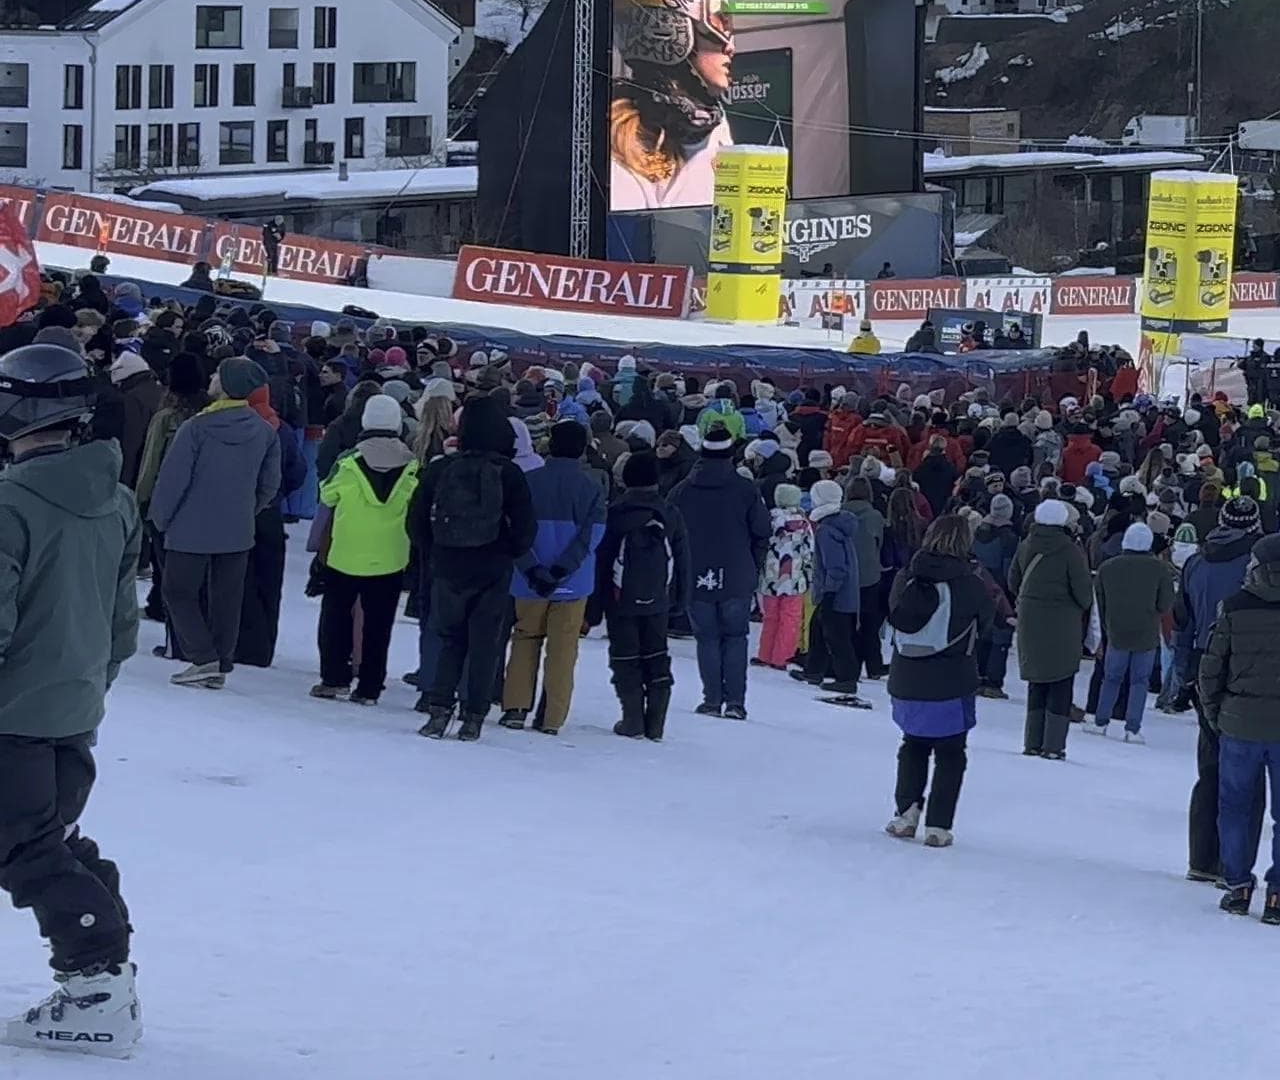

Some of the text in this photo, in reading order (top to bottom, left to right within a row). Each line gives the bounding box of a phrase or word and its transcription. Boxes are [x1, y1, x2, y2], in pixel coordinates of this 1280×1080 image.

[46, 203, 203, 257] GENERALI
[782, 214, 872, 244] NGINES
[1149, 220, 1187, 233] ZGONC
[465, 256, 678, 310] GENERALI
[1231, 281, 1277, 302] NERALI
[873, 287, 961, 312] GENERALI
[1057, 285, 1131, 307] GENERALI
[36, 1029, 114, 1043] HEAD
